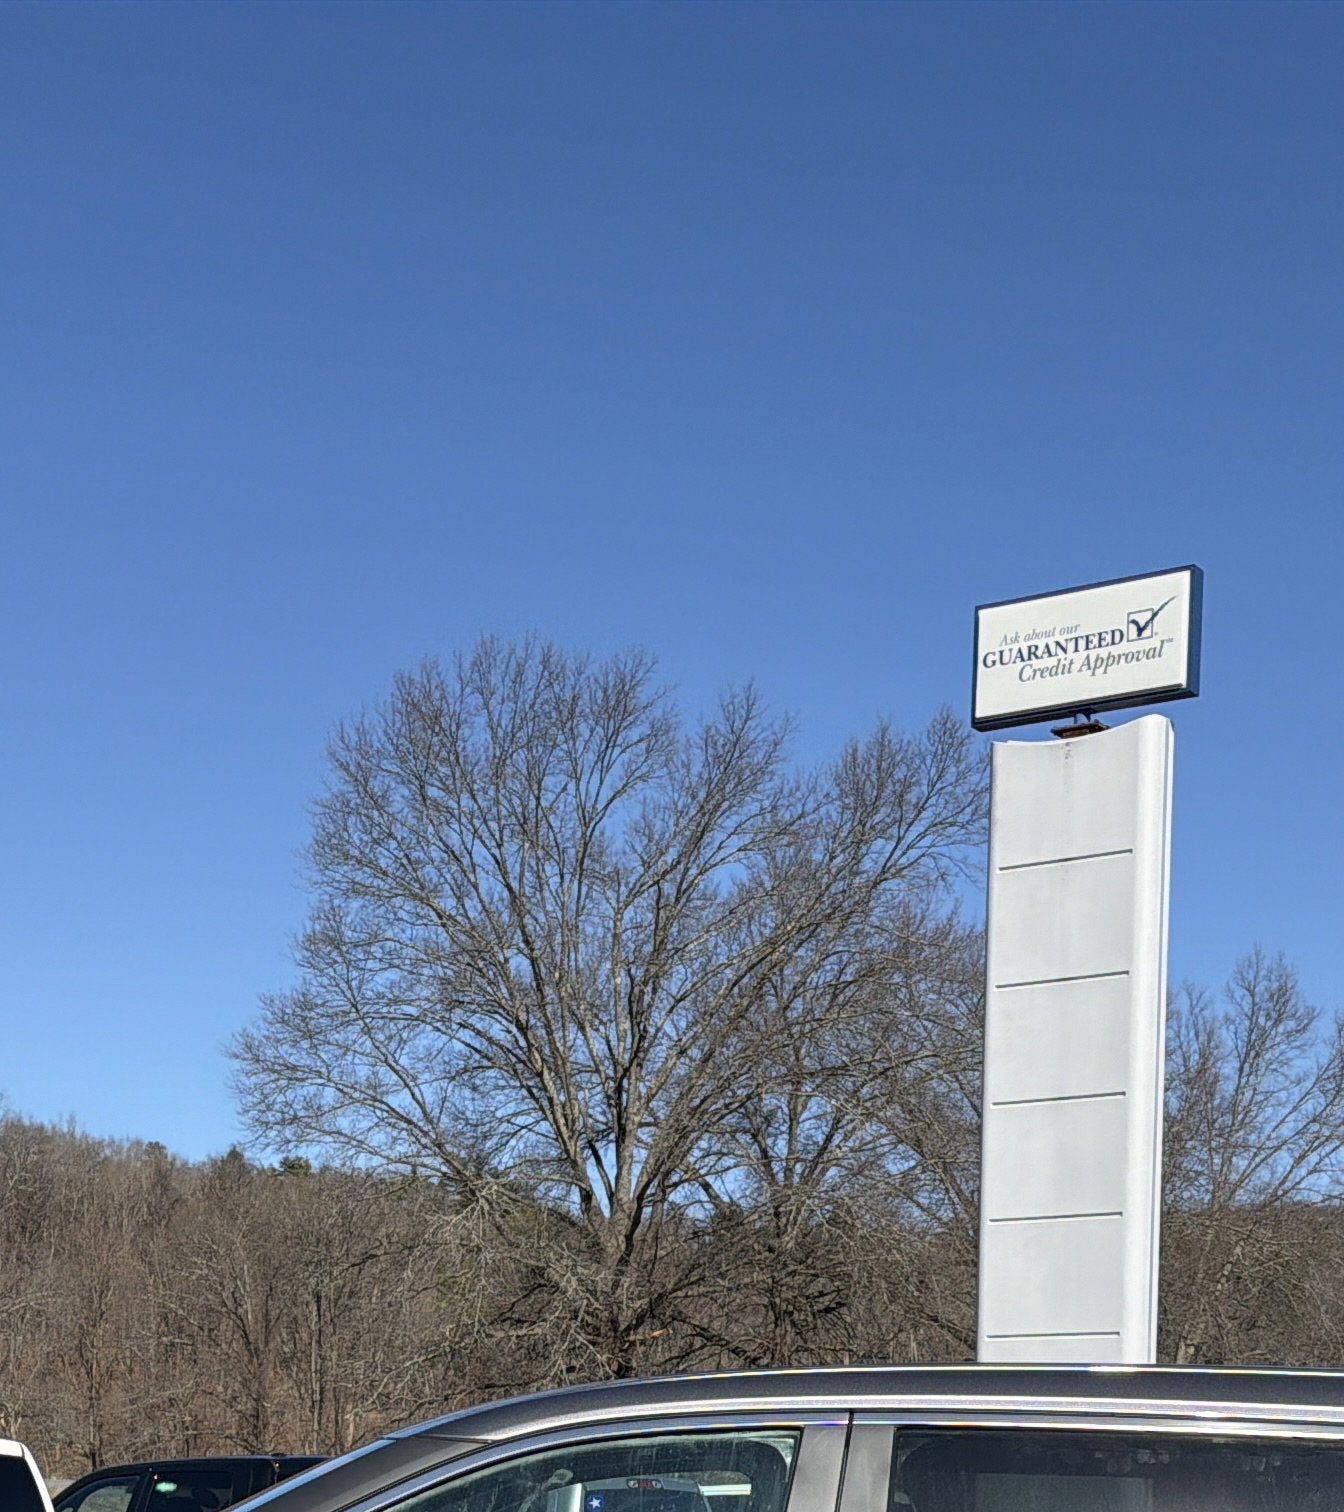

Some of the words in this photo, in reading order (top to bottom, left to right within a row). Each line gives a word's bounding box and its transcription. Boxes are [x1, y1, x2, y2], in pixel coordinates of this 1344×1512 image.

[999, 631, 1021, 646] Ask
[1024, 627, 1056, 641] about
[1058, 624, 1080, 636] our
[982, 628, 1124, 669] GUARANTEED
[1018, 657, 1074, 683] Credit
